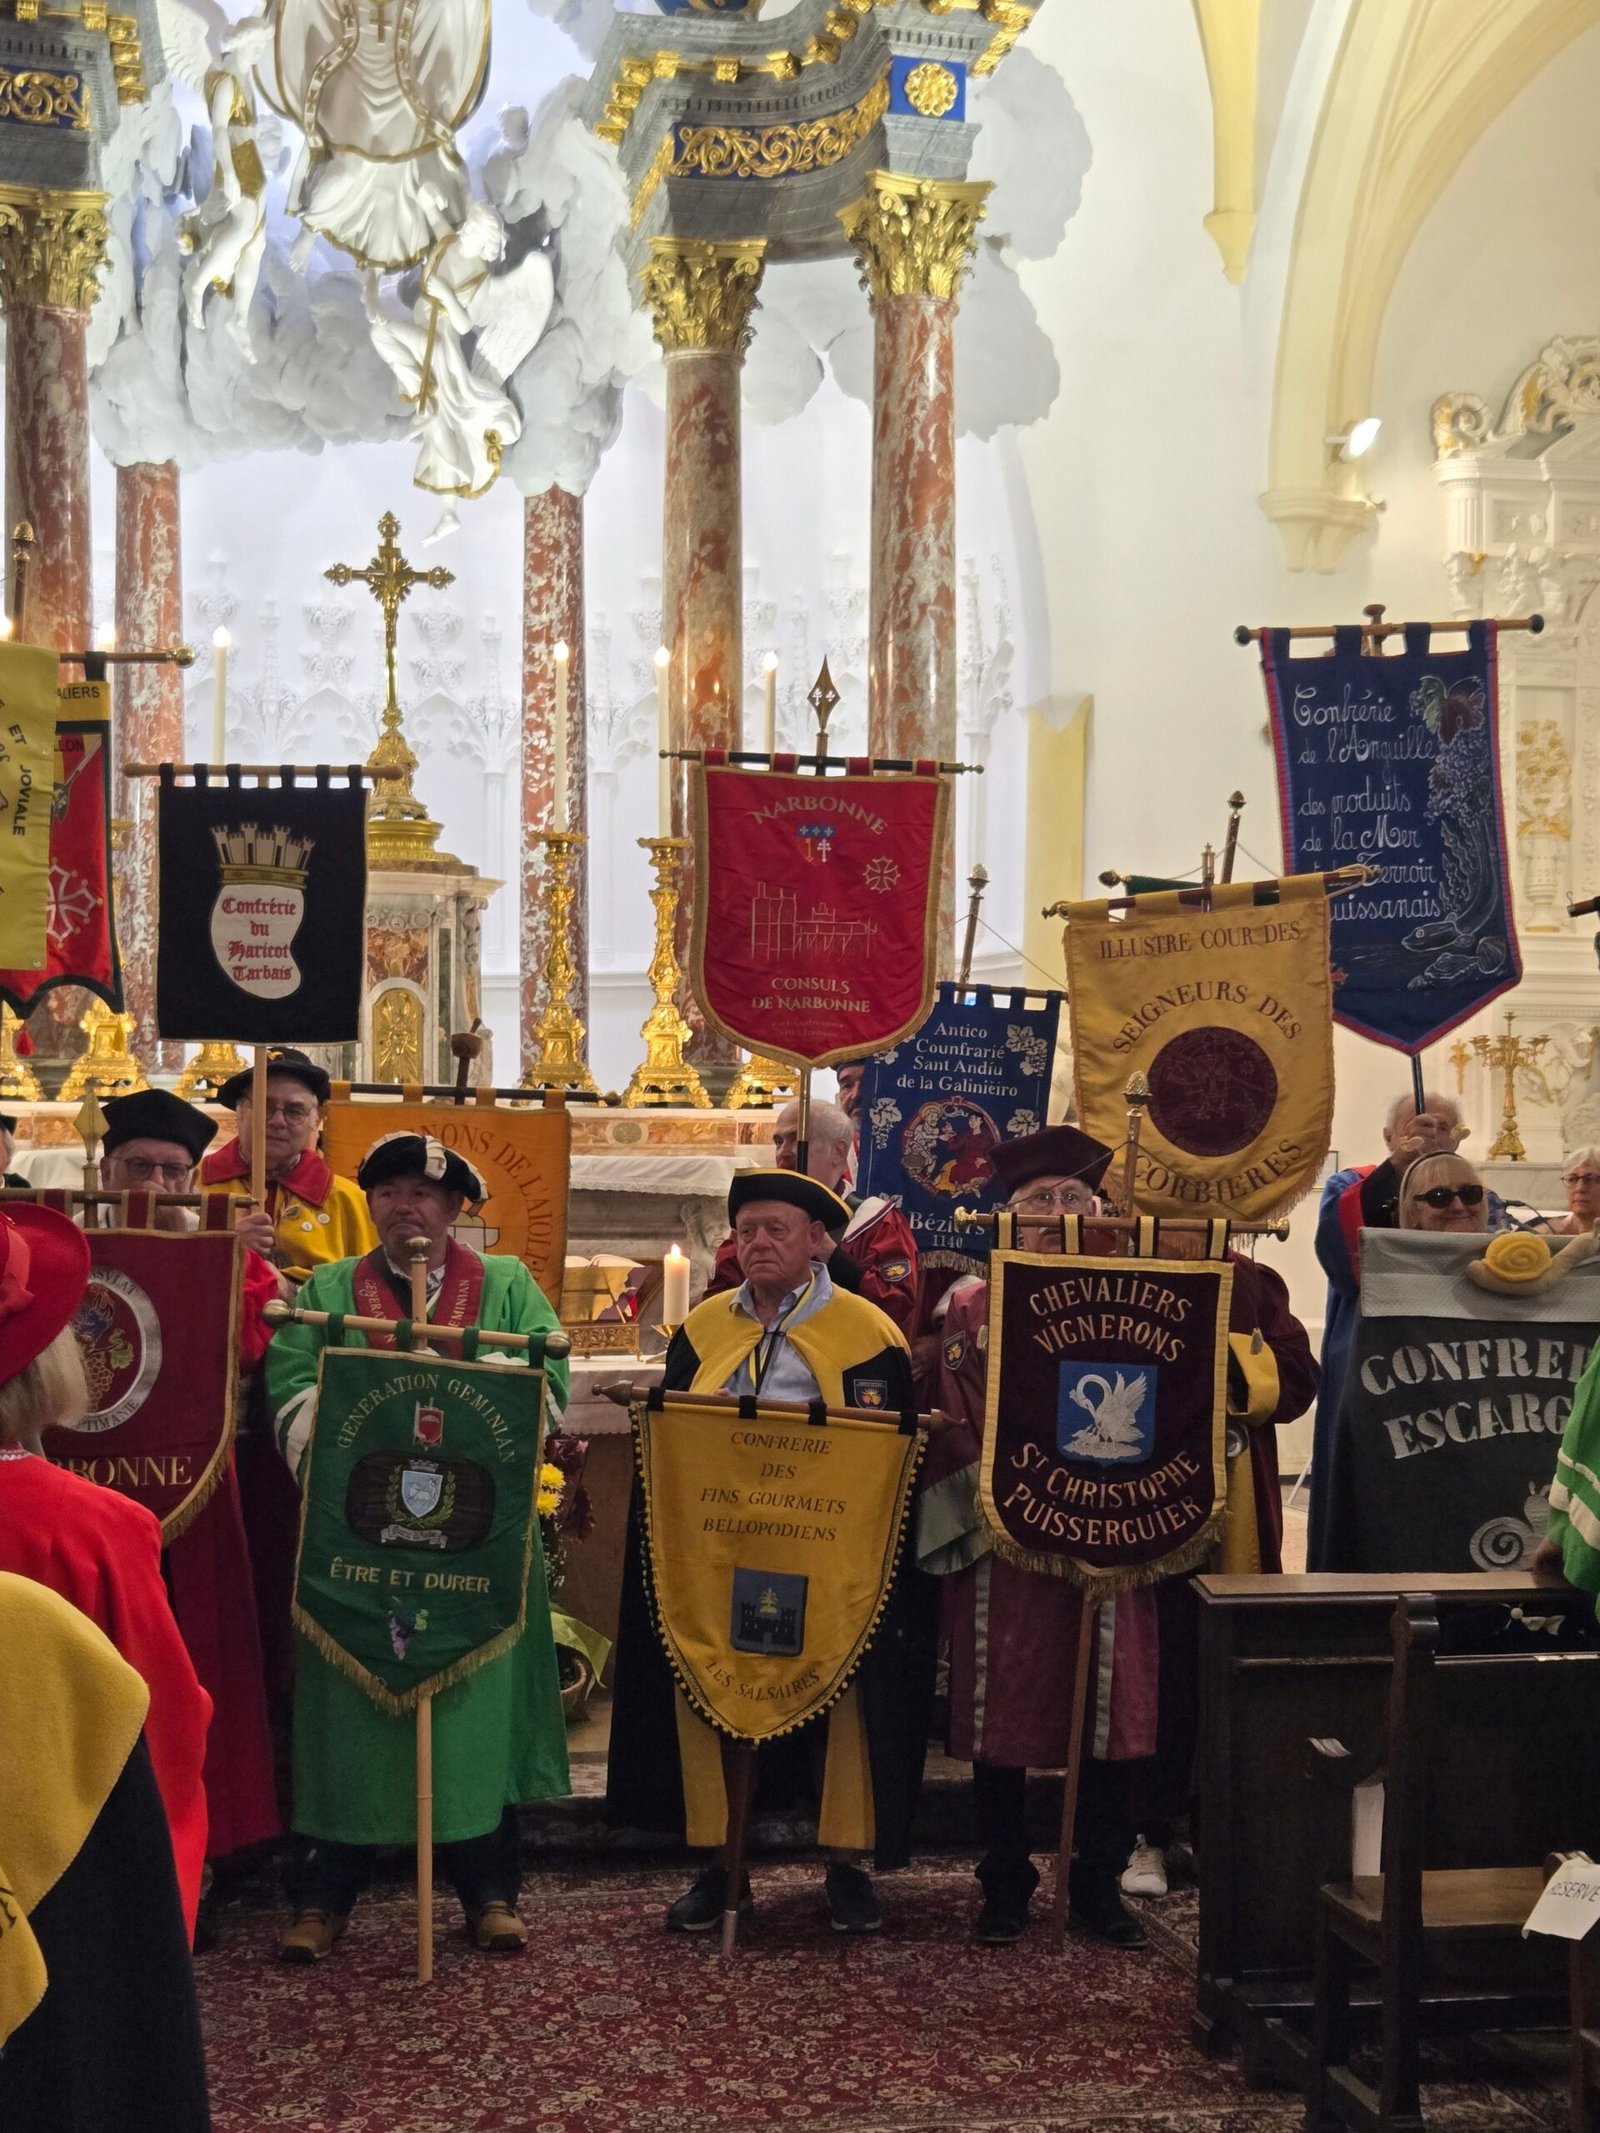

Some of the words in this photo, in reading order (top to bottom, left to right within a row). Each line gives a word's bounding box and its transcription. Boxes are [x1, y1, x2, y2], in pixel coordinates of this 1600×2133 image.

[1293, 683, 1397, 741] Confrérie
[8, 724, 27, 745] ET
[54, 739, 85, 752] LON
[1298, 736, 1318, 765] de
[1326, 724, 1437, 784] l'Anguille
[13, 764, 32, 836] JOVIALE
[1298, 788, 1326, 816] des
[1331, 775, 1411, 832] produits
[750, 795, 888, 836] NARBONNE
[1300, 826, 1322, 851] de
[1331, 816, 1358, 851] la
[1360, 814, 1422, 849] Mer
[222, 896, 297, 916] Confrérie
[250, 920, 270, 937] du
[1100, 933, 1192, 959] ILLUSTRE
[1201, 926, 1254, 950] COUR
[1263, 920, 1300, 944] DES
[228, 940, 289, 962] Haricot
[232, 965, 294, 982] Tarbais
[771, 975, 850, 994] CONSULS
[752, 996, 773, 1010] DE
[775, 994, 870, 1014] NARBONNE
[1113, 980, 1248, 1054] SEIGNEURS
[1256, 994, 1302, 1040] DES
[934, 1022, 988, 1039] Antico
[916, 1038, 1005, 1060] Counfrarié
[913, 1055, 950, 1072] Sant
[896, 1074, 916, 1089] de
[920, 1075, 933, 1090] la
[938, 1075, 1018, 1097] Galinièiro
[493, 1141, 532, 1179] DE
[932, 1234, 963, 1249] 1140
[336, 1372, 440, 1449] GENERATION
[447, 1378, 517, 1463] GEMINIAN
[730, 1431, 832, 1454] CONFRERIE
[760, 1463, 797, 1480] DES
[1046, 1450, 1201, 1509] CHRISTOPHE
[700, 1487, 740, 1504] FINS
[748, 1491, 847, 1514] GOURMETS
[702, 1517, 837, 1542] BELLOPODIENS
[330, 1556, 380, 1583] ÊTRE
[389, 1571, 415, 1587] ET
[425, 1574, 490, 1593] DURER
[705, 1662, 735, 1687] LES
